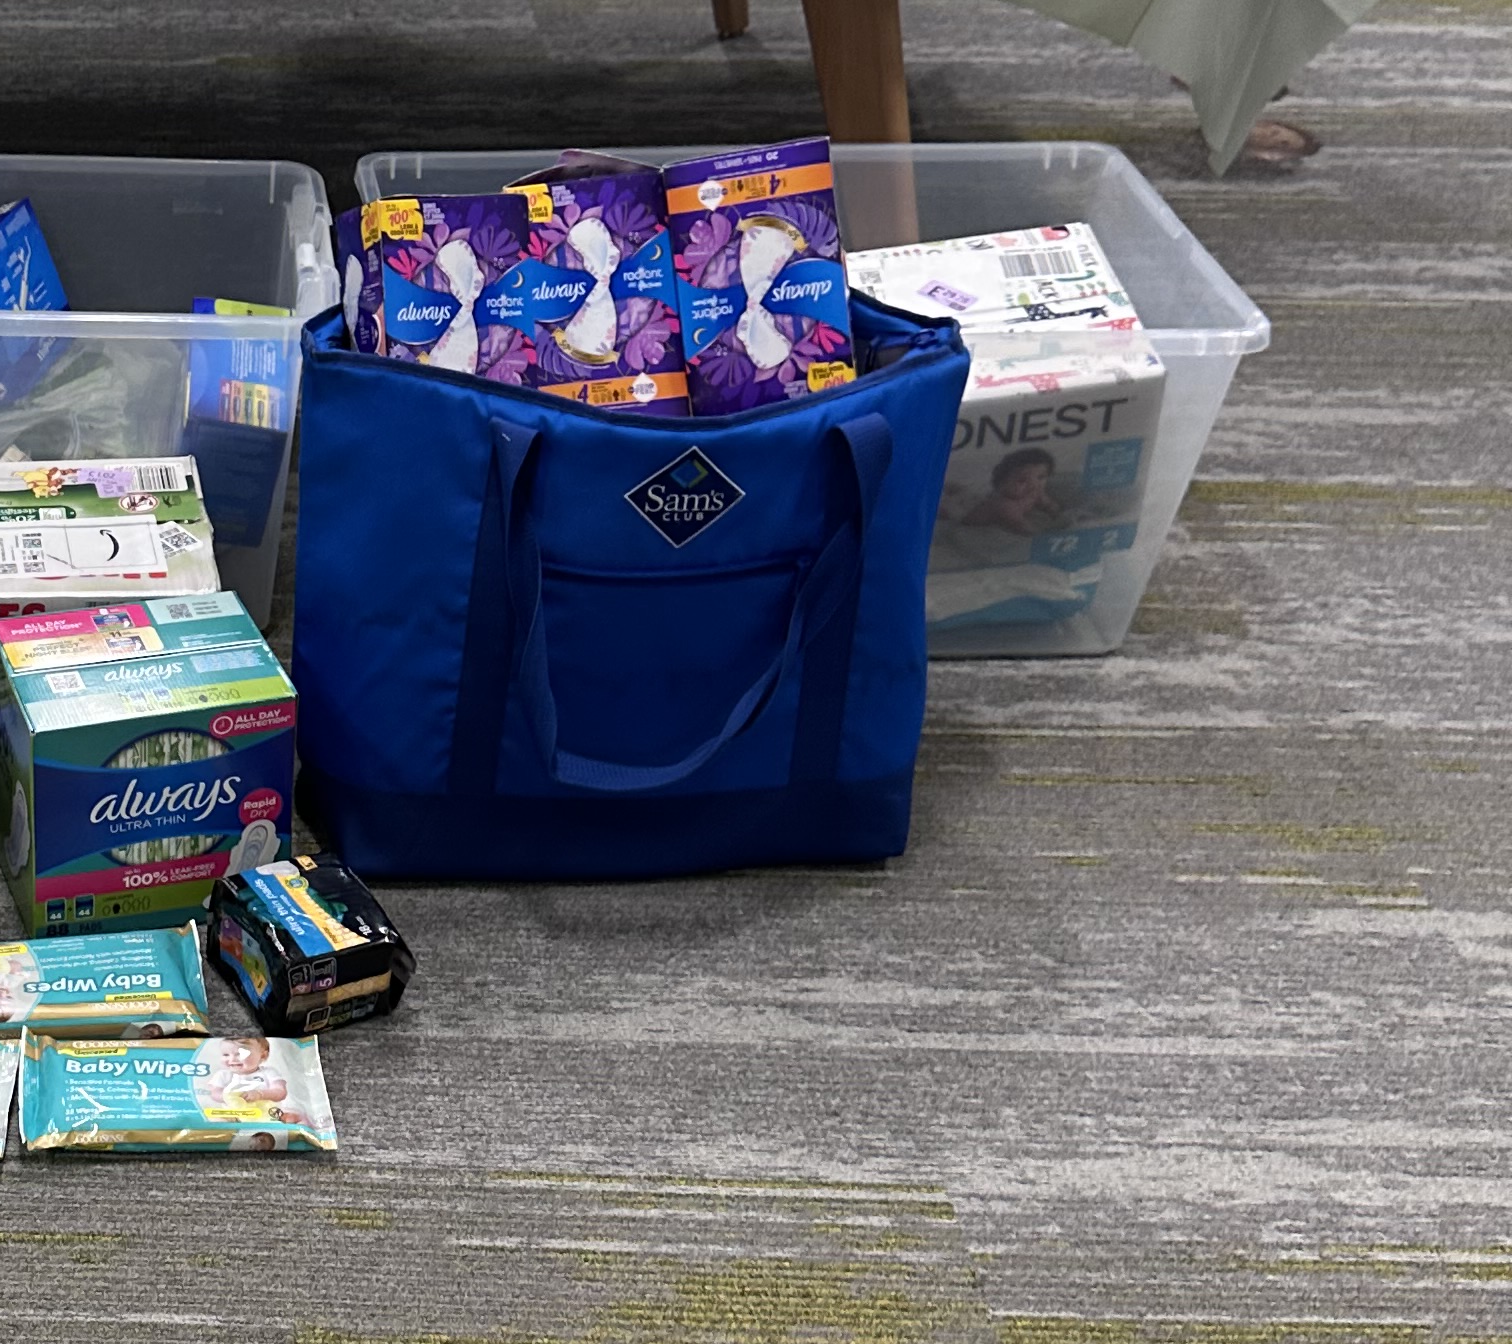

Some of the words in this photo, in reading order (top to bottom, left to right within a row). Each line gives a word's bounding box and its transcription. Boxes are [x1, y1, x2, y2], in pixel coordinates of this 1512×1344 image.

[772, 280, 832, 302] always
[397, 303, 451, 325] always
[645, 484, 724, 513] Sam's
[663, 512, 704, 521] CLUB
[104, 661, 184, 683] always
[235, 712, 258, 723] ALL
[259, 709, 281, 720] DAY
[90, 776, 241, 823] always
[244, 797, 276, 810] Rapid
[110, 820, 151, 833] ULTRA
[155, 815, 186, 826] THIN
[123, 871, 168, 888] 100%
[24, 977, 98, 992] Wipes
[103, 973, 161, 989] Baby
[66, 1059, 128, 1076] Baby
[134, 1061, 210, 1076] Wipes
